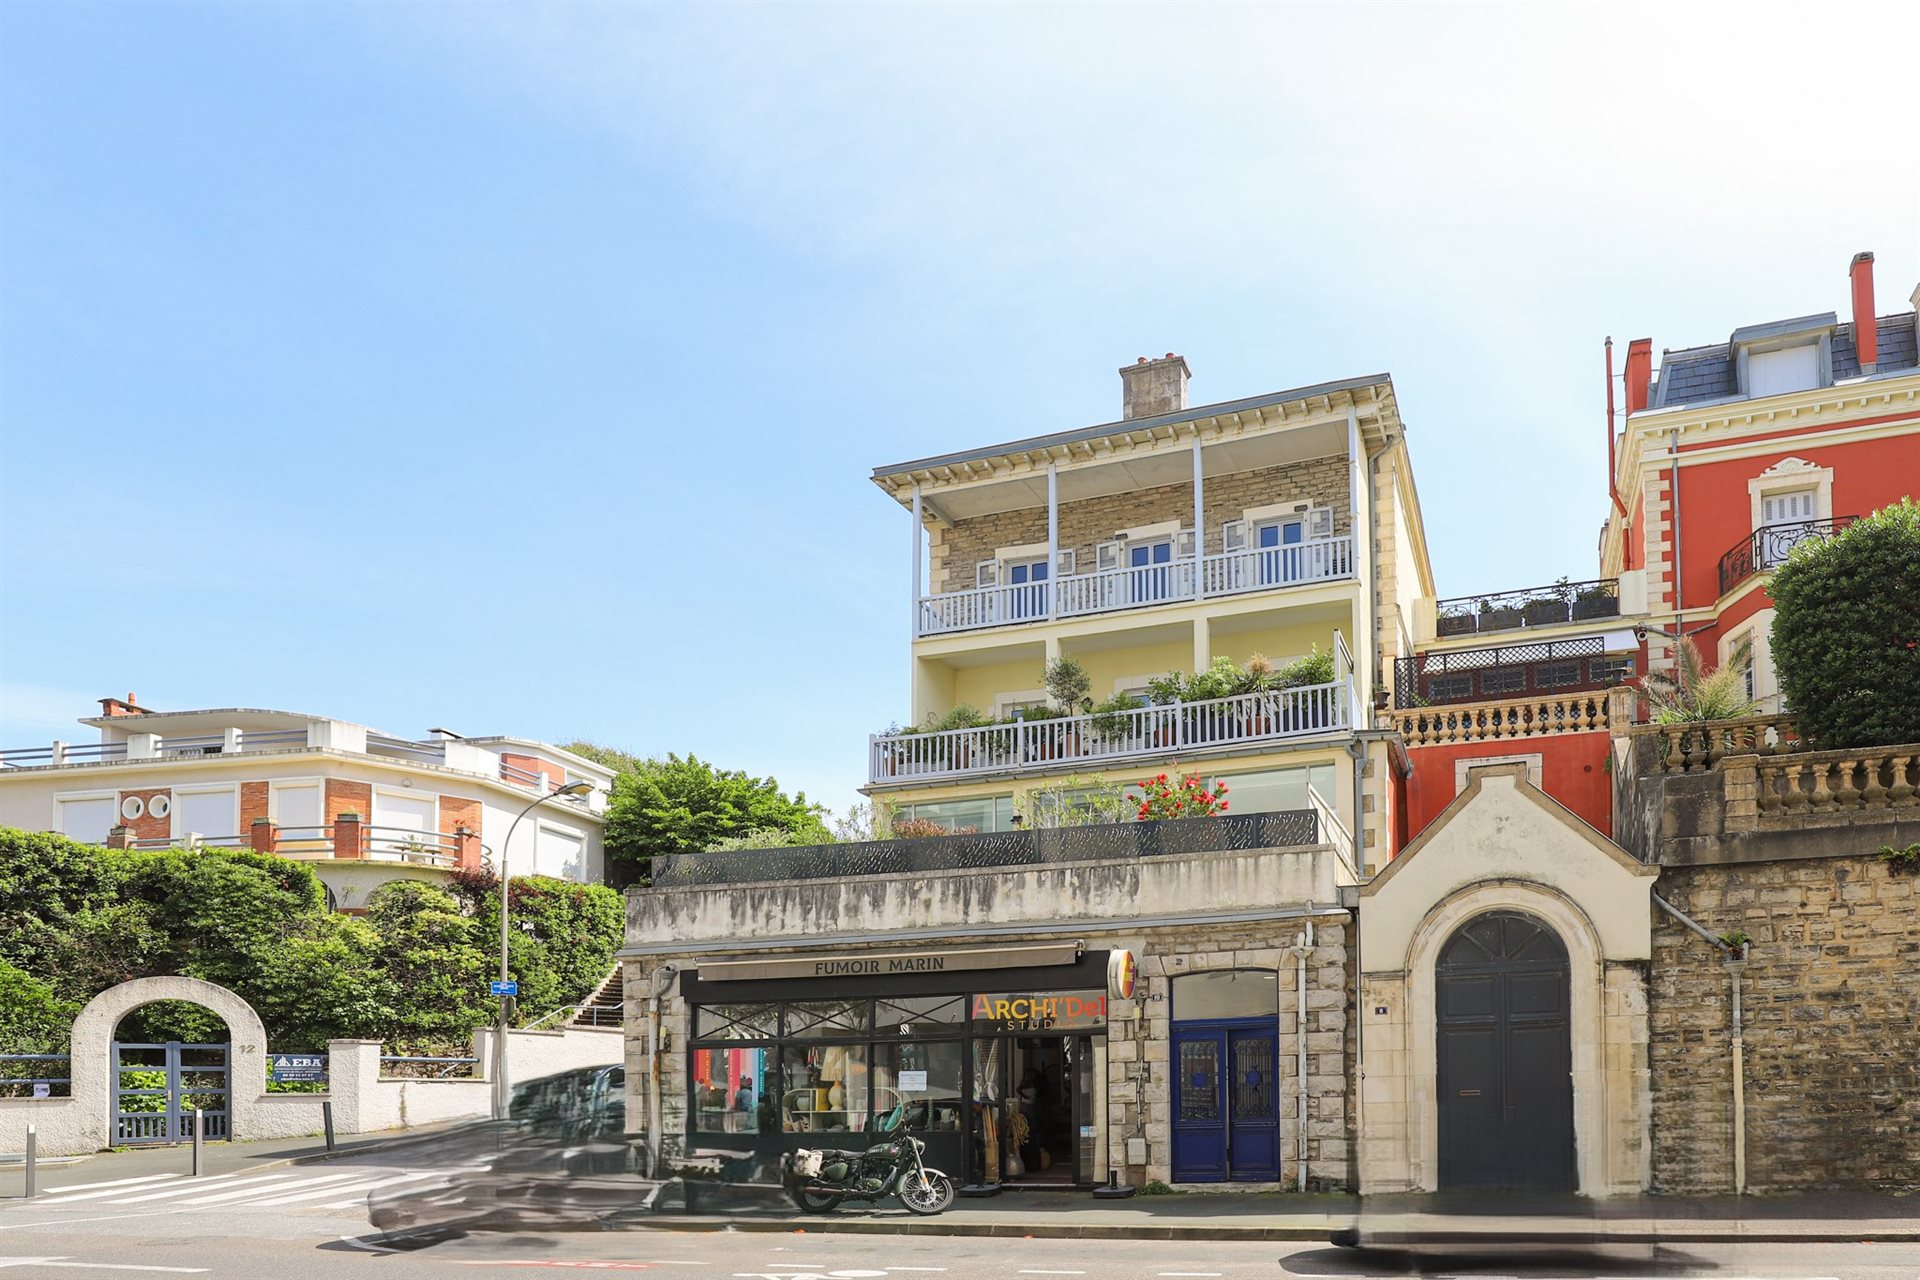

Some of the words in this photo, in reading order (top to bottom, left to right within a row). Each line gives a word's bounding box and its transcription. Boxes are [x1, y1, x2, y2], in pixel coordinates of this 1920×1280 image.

[815, 960, 880, 975] FUMOIR
[889, 957, 944, 972] MARIN
[239, 1044, 256, 1054] 12
[292, 1058, 322, 1067] EBA
